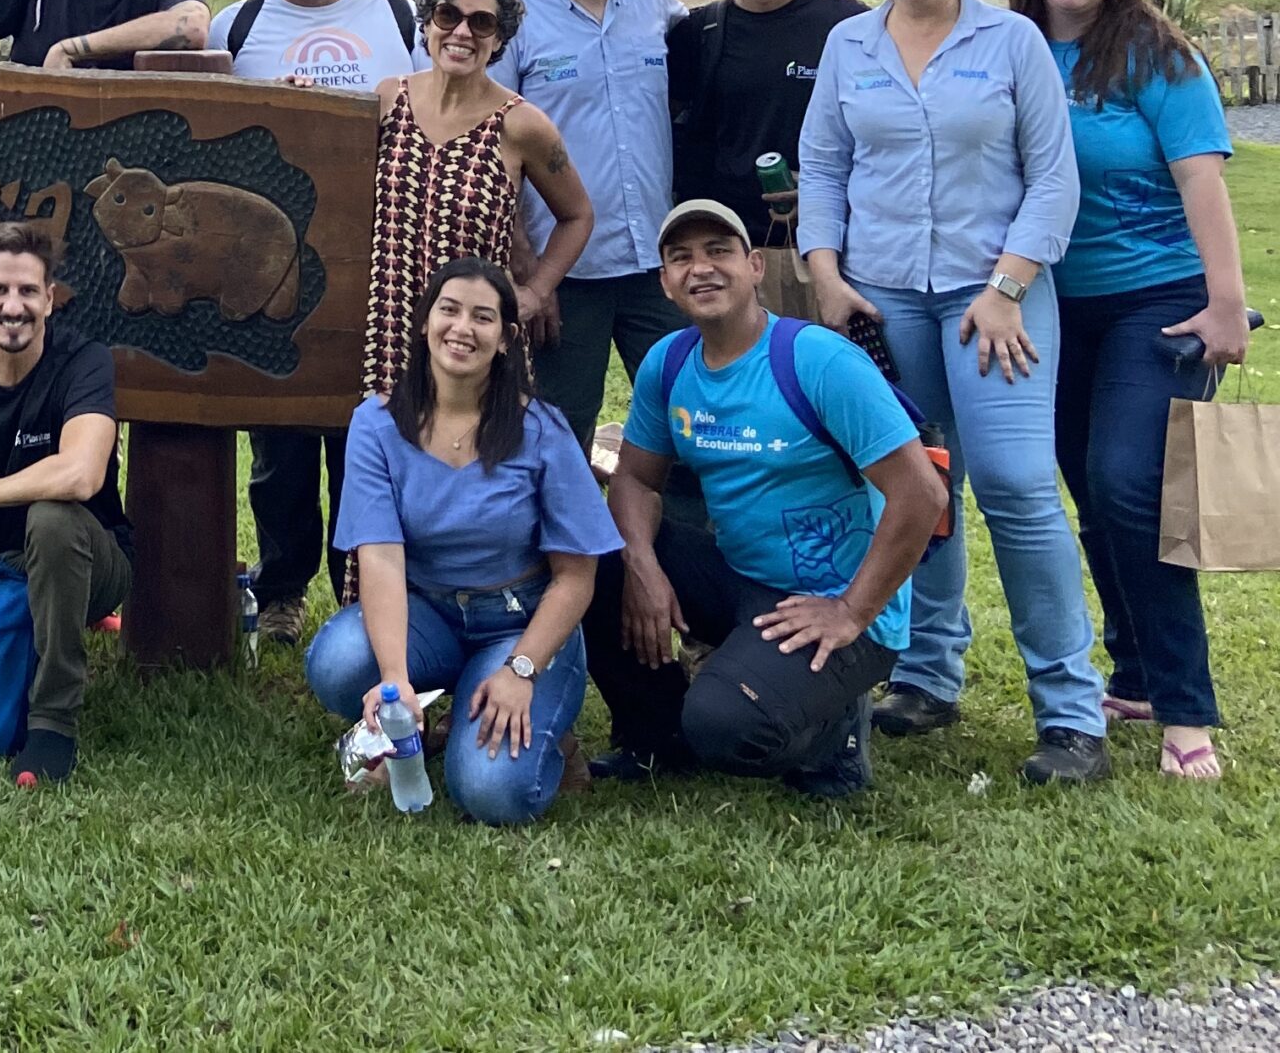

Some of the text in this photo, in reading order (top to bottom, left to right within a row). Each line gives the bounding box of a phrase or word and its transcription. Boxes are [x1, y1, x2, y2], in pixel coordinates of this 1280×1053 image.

[294, 63, 361, 76] OUTDOOR
[313, 73, 369, 88] ERIENCE
[694, 410, 716, 423] Polo
[695, 424, 757, 438] SEBRAE de
[696, 436, 762, 452] Ecoturismo
